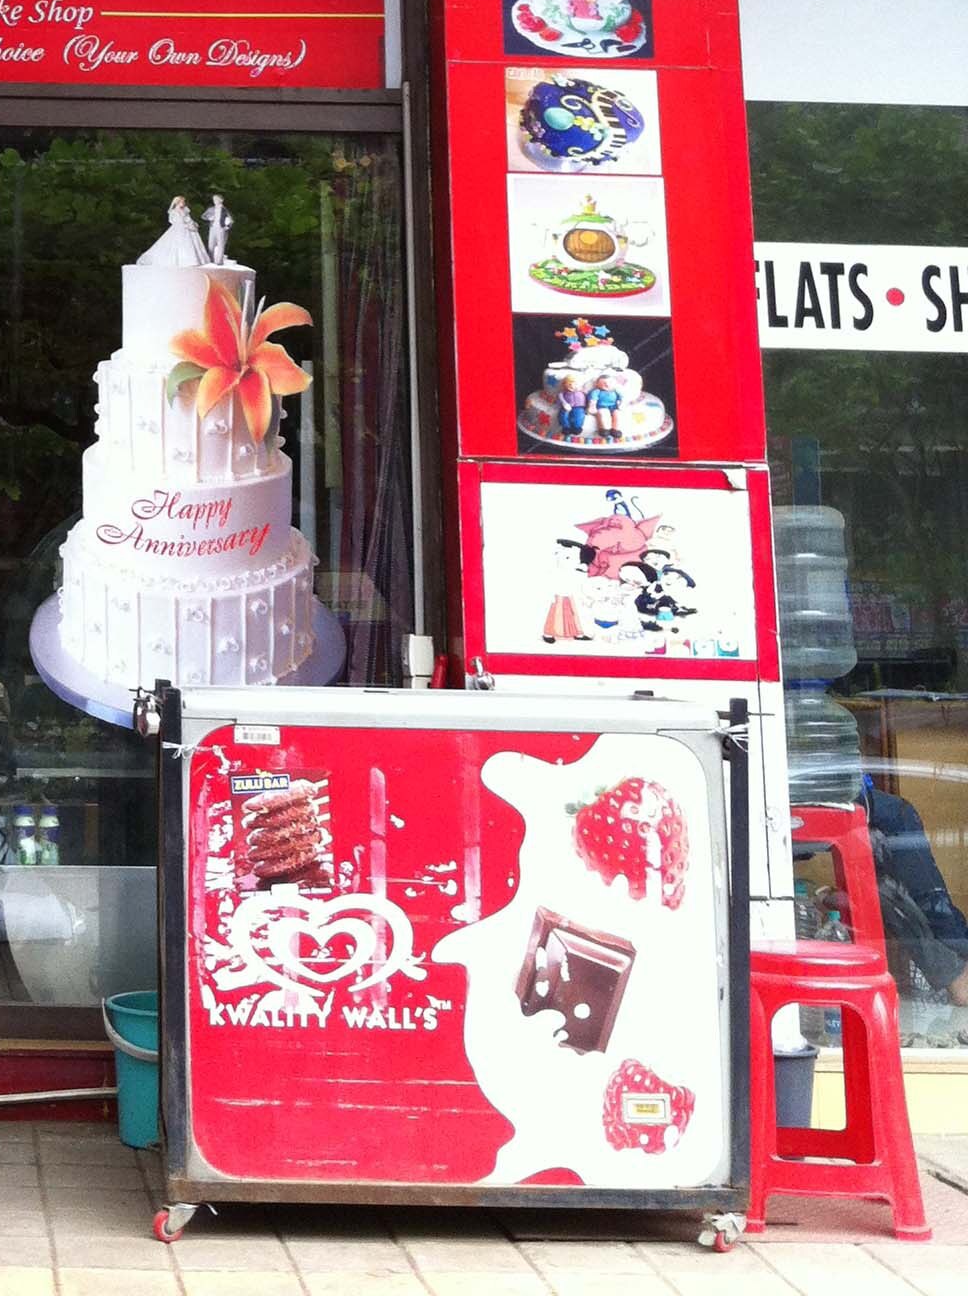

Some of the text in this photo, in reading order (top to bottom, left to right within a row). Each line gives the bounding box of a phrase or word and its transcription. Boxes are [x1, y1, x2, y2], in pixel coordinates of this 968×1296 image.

[62, 34, 139, 72] (Your
[147, 38, 201, 66] Own
[205, 37, 308, 78] Designs)
[754, 260, 874, 332] LATS
[131, 488, 233, 531] Happy
[96, 518, 271, 559] Anniversary
[209, 1003, 331, 1029] KWALITY
[343, 1005, 440, 1031] WALL'S
